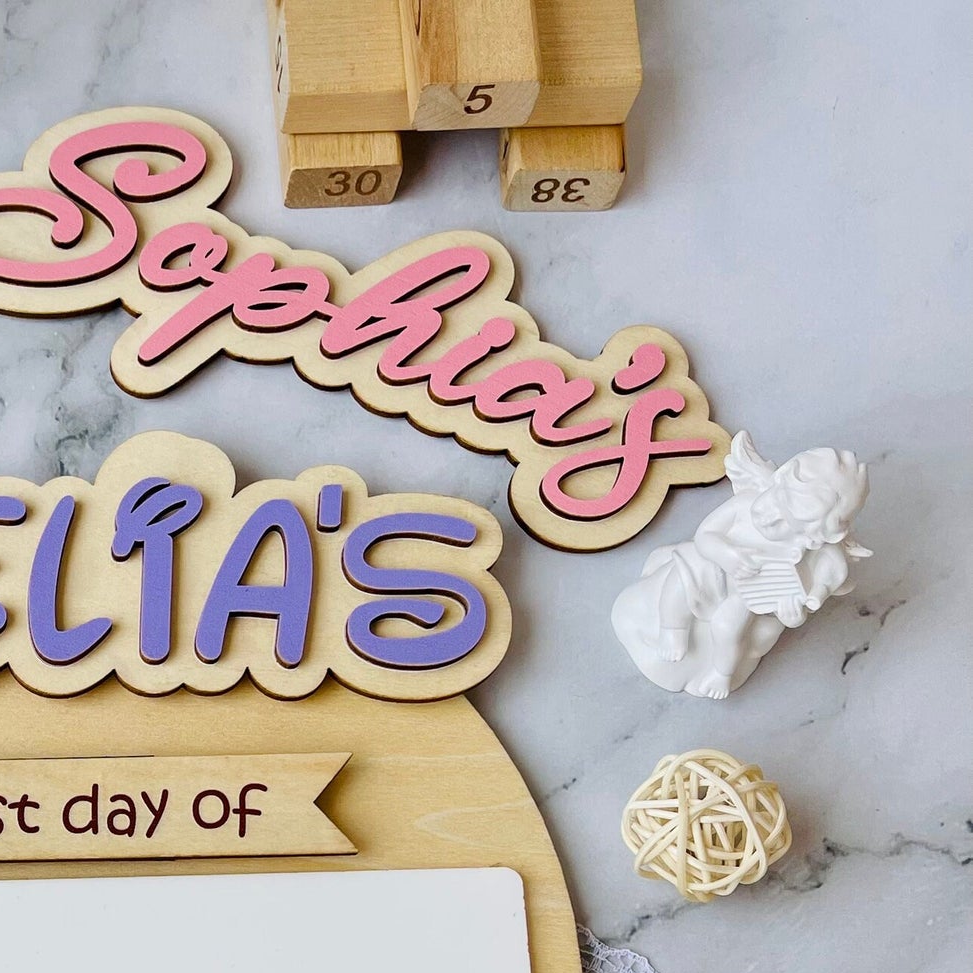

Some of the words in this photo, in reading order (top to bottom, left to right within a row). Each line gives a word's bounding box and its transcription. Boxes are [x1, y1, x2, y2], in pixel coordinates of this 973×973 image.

[463, 83, 496, 115] 5
[324, 169, 382, 197] 30
[530, 177, 591, 203] 38
[61, 782, 169, 839] day
